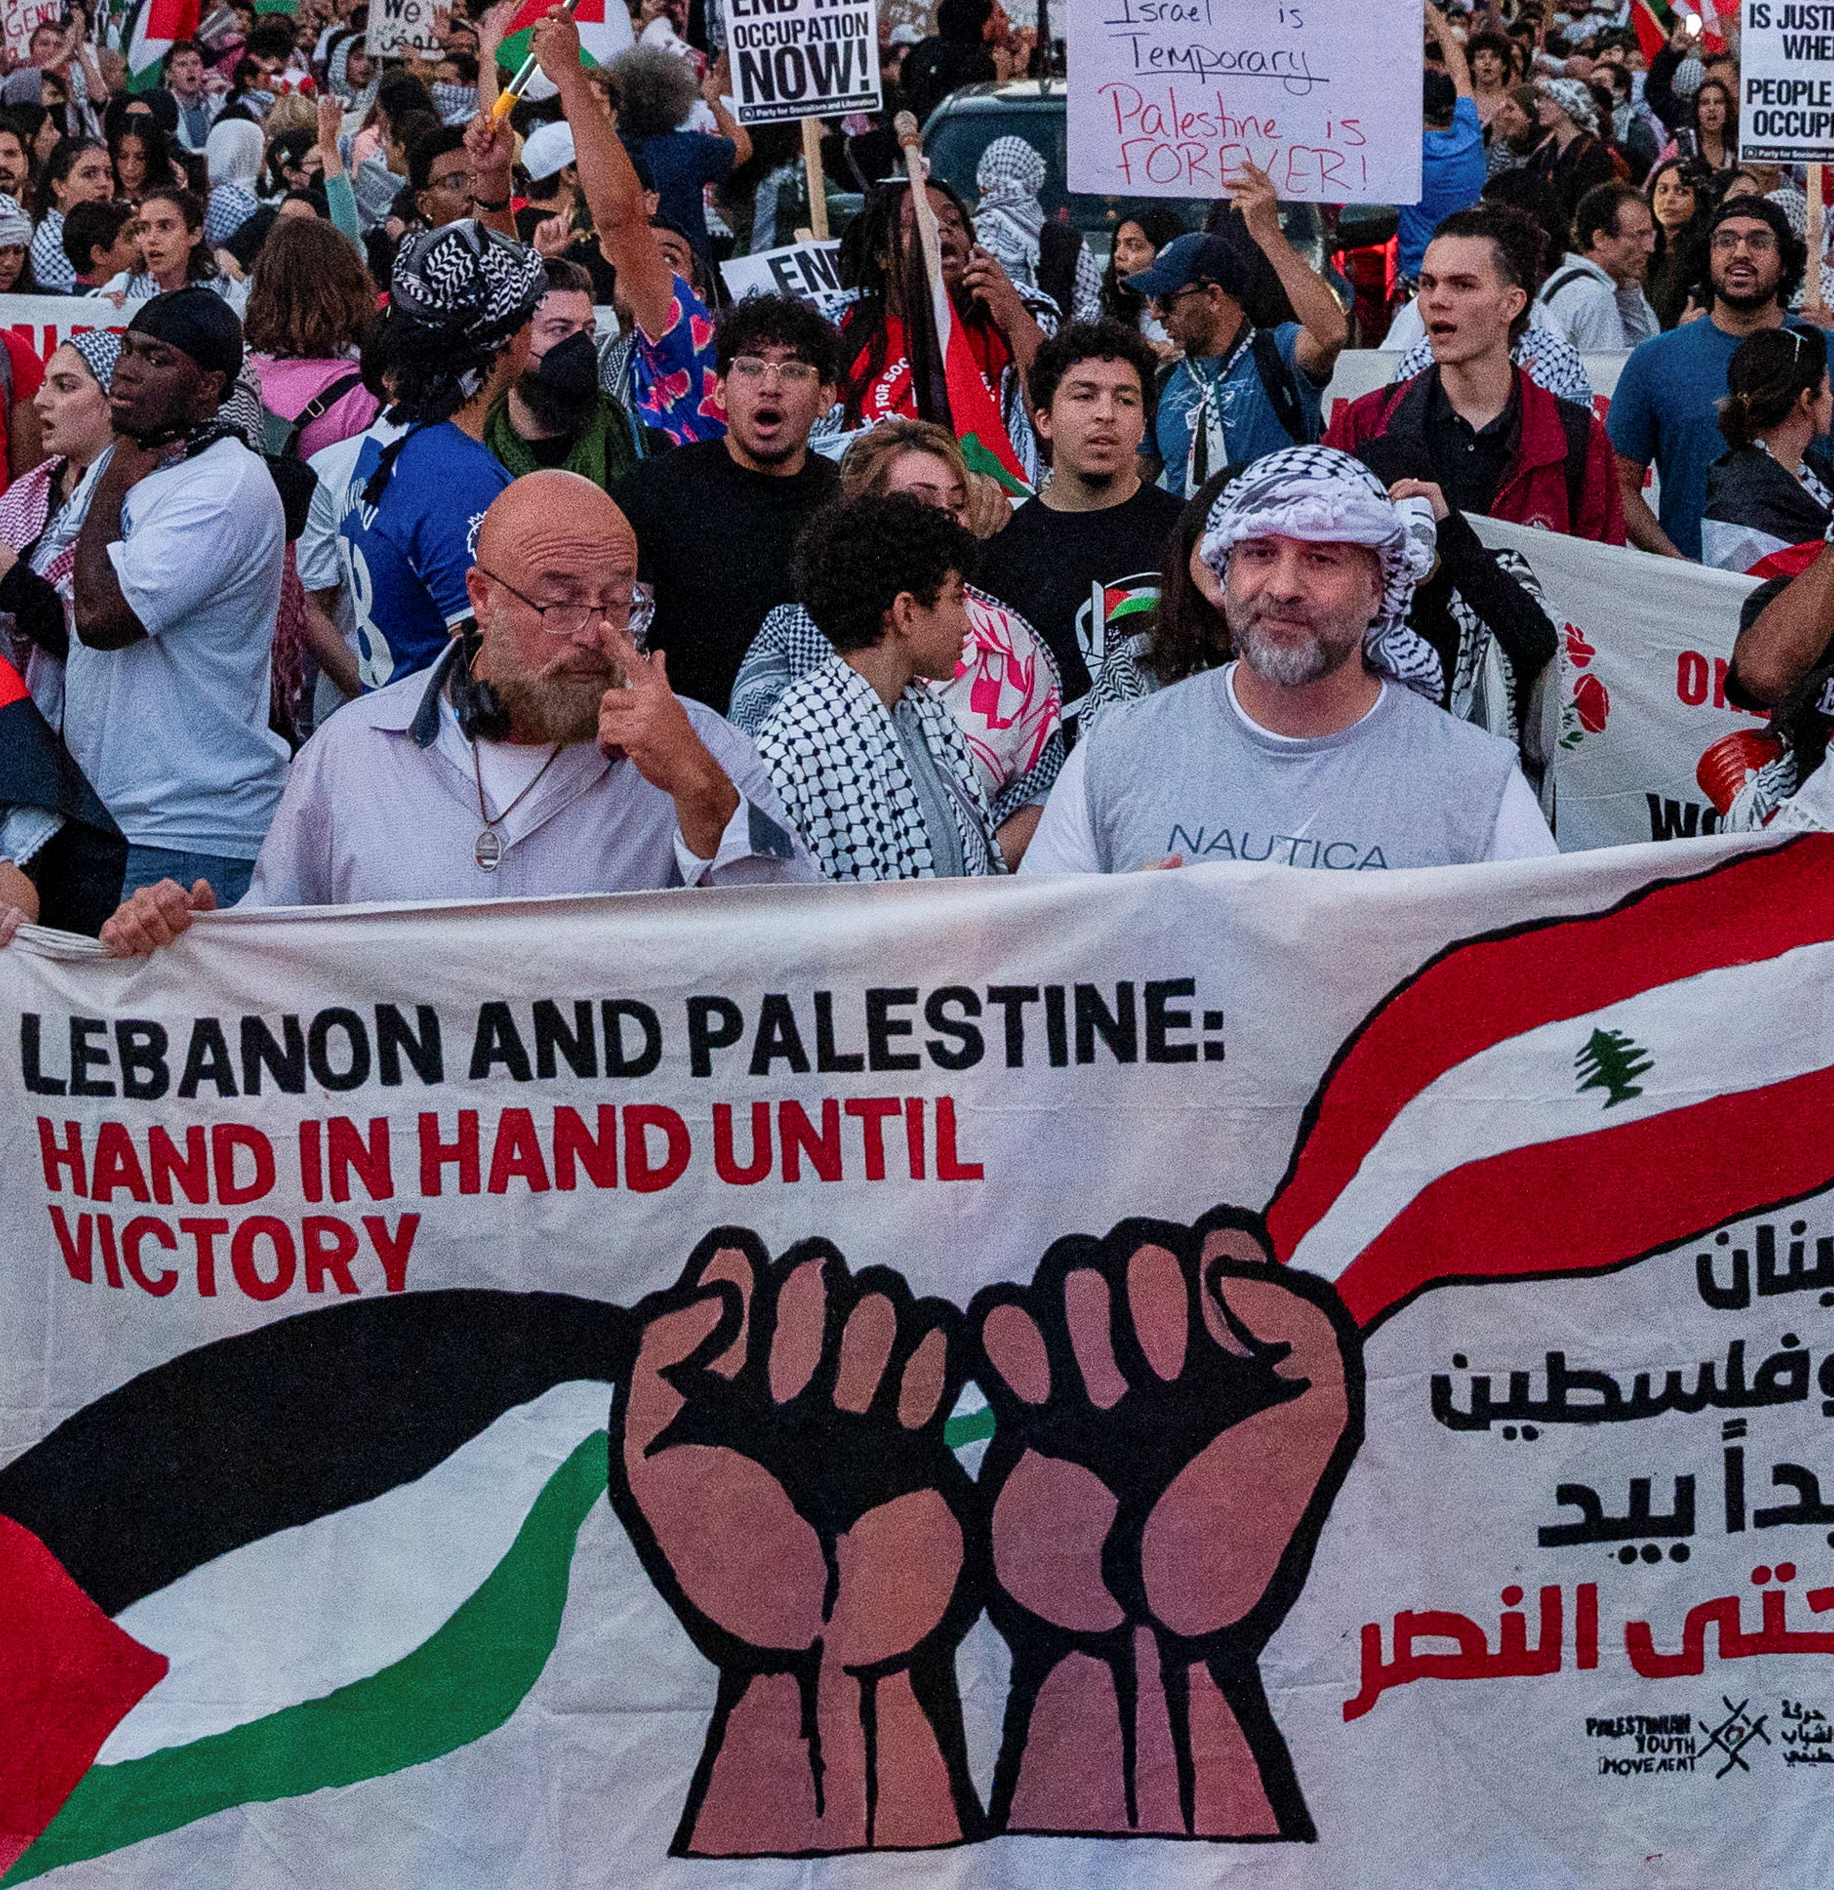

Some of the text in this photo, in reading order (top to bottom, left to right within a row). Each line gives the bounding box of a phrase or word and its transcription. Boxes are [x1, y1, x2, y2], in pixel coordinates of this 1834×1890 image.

[734, 12, 869, 49] OCCUPATION
[1278, 2, 1304, 29] is
[1749, 4, 1771, 29] IS
[738, 38, 870, 103] NOW!
[1110, 32, 1314, 95] Temporary
[1098, 83, 1367, 146] Palestine is
[1747, 79, 1832, 108] PEOPLE
[1117, 138, 1369, 194] FOREVER!
[875, 382, 892, 409] FOR
[1168, 824, 1389, 871] NAUTICA
[20, 976, 1227, 1101] LEBANON AND PALESTINE:
[38, 1095, 985, 1207] HAND IN HAND UNTIL
[49, 1206, 420, 1302] VICTORY
[1538, 1474, 1696, 1564] بيد
[1341, 1582, 1599, 1722] النصر
[1586, 1713, 1692, 1737] PALESTINIAN
[1636, 1735, 1696, 1755] YOUTH
